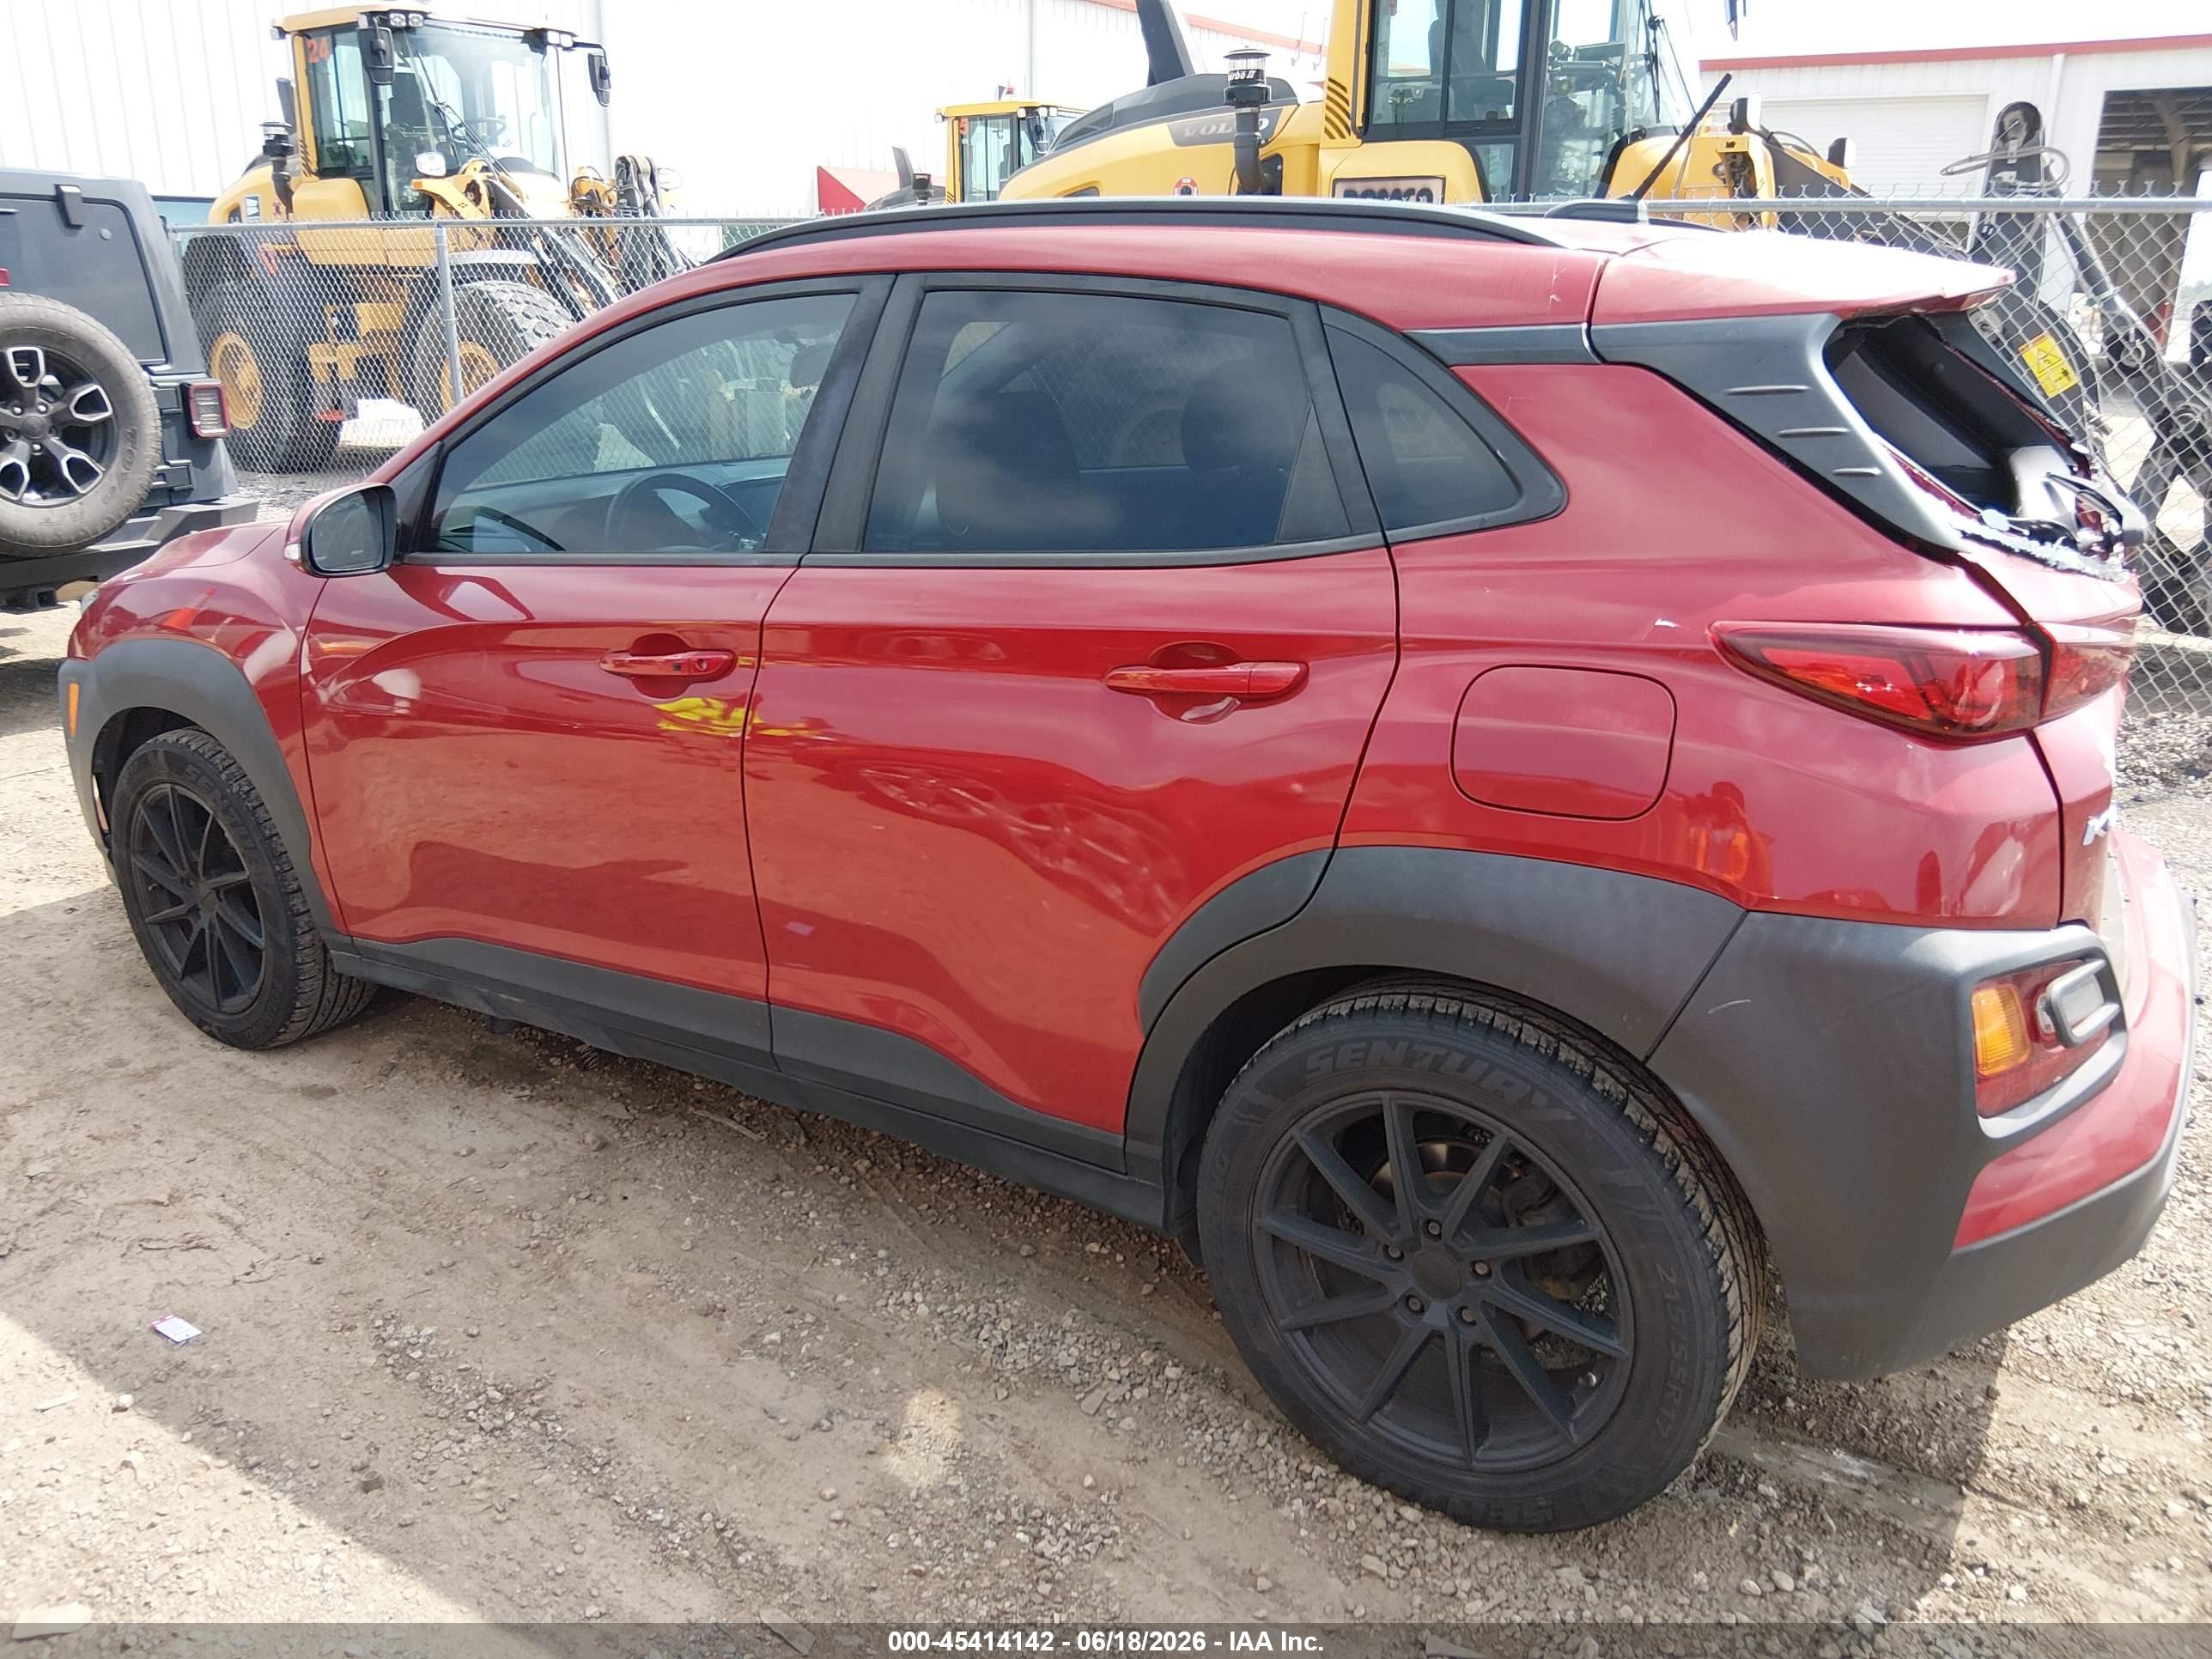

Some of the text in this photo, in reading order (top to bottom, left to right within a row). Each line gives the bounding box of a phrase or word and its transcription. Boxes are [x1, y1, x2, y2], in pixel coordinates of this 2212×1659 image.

[1182, 118, 1270, 138] VOLO
[1305, 1038, 1577, 1121] SENTURY
[1654, 1262, 1690, 1440] 215/55R17
